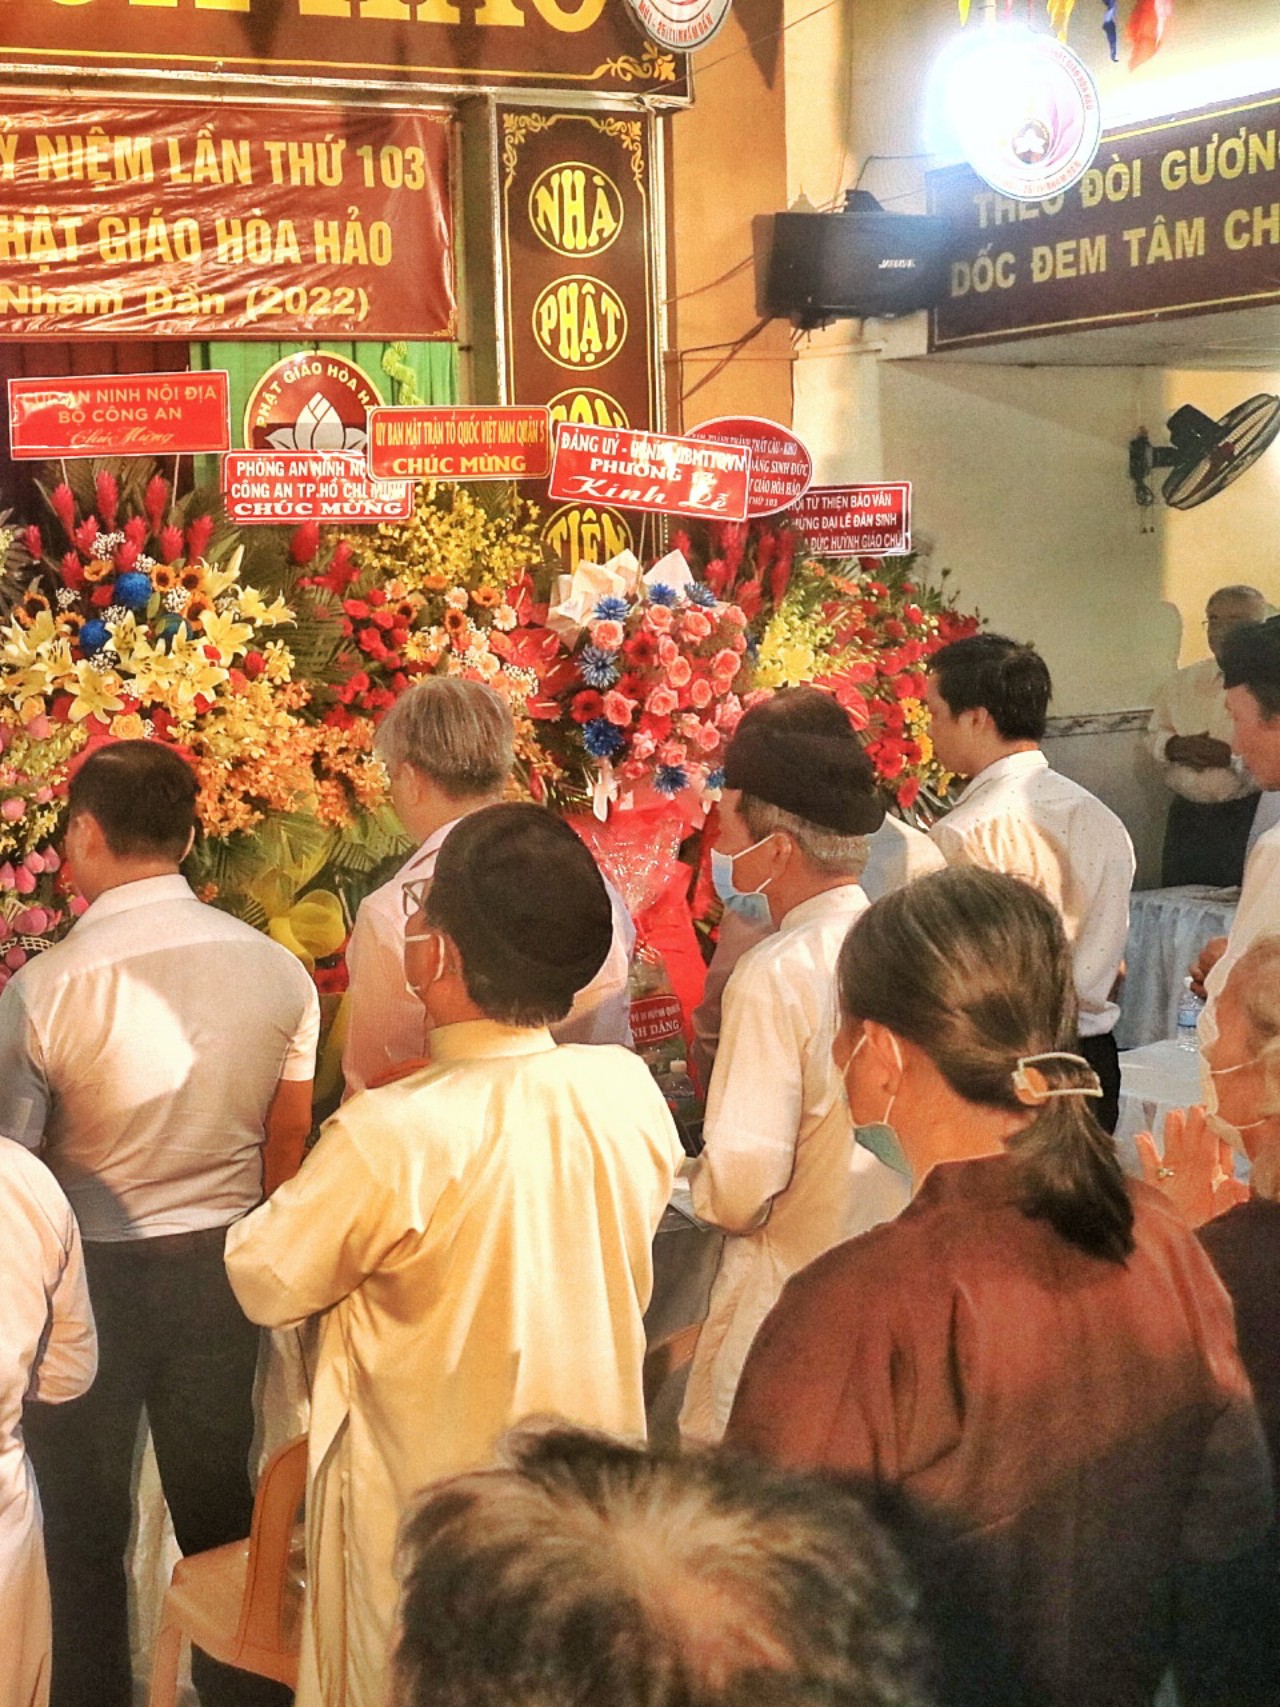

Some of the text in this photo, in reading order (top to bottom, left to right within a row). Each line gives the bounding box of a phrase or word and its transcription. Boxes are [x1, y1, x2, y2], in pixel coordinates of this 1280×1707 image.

[35, 127, 154, 191] NIỆM
[167, 122, 252, 185] LẦN
[264, 134, 346, 187] THỨ
[356, 145, 425, 190] 103
[1080, 153, 1142, 208] ĐÒI
[1160, 126, 1280, 191] GƯƠN
[535, 169, 617, 250] NHÀ
[98, 208, 202, 264] GIÁO
[215, 208, 302, 265] HÒA
[314, 206, 392, 266] HẢO
[950, 243, 1016, 297] DỐC
[1030, 235, 1107, 284] ĐEM
[1123, 215, 1205, 267] TÂM
[246, 286, 369, 322] (2022)
[539, 282, 621, 363] PHẬT
[97, 387, 141, 403] NINH
[146, 384, 178, 405] NỘI
[184, 385, 217, 404] ĐỊA
[256, 360, 358, 428] PHẬT GIÁO HÒA
[58, 405, 182, 426] BỘ CÔNG AN
[388, 422, 403, 445] BAN
[423, 417, 444, 449] TRẬN
[458, 415, 479, 447] QUỐC
[498, 420, 516, 444] NAM
[517, 416, 538, 447] QUẬN
[561, 428, 598, 453] ĐẢNG
[236, 456, 345, 477] PHÒNG AN NINH
[392, 453, 526, 475] CHÚC MỪNG
[231, 479, 270, 498] CÔNG
[274, 482, 293, 498] AN
[562, 475, 668, 505] Kính
[806, 492, 870, 512] TỪ THIỆN BẢO
[234, 498, 403, 515] CHÚC MỪNG
[821, 516, 838, 532] ĐẠI
[876, 513, 897, 526] SINH
[831, 532, 859, 549] HUỲNH
[861, 531, 881, 547] GIÁO
